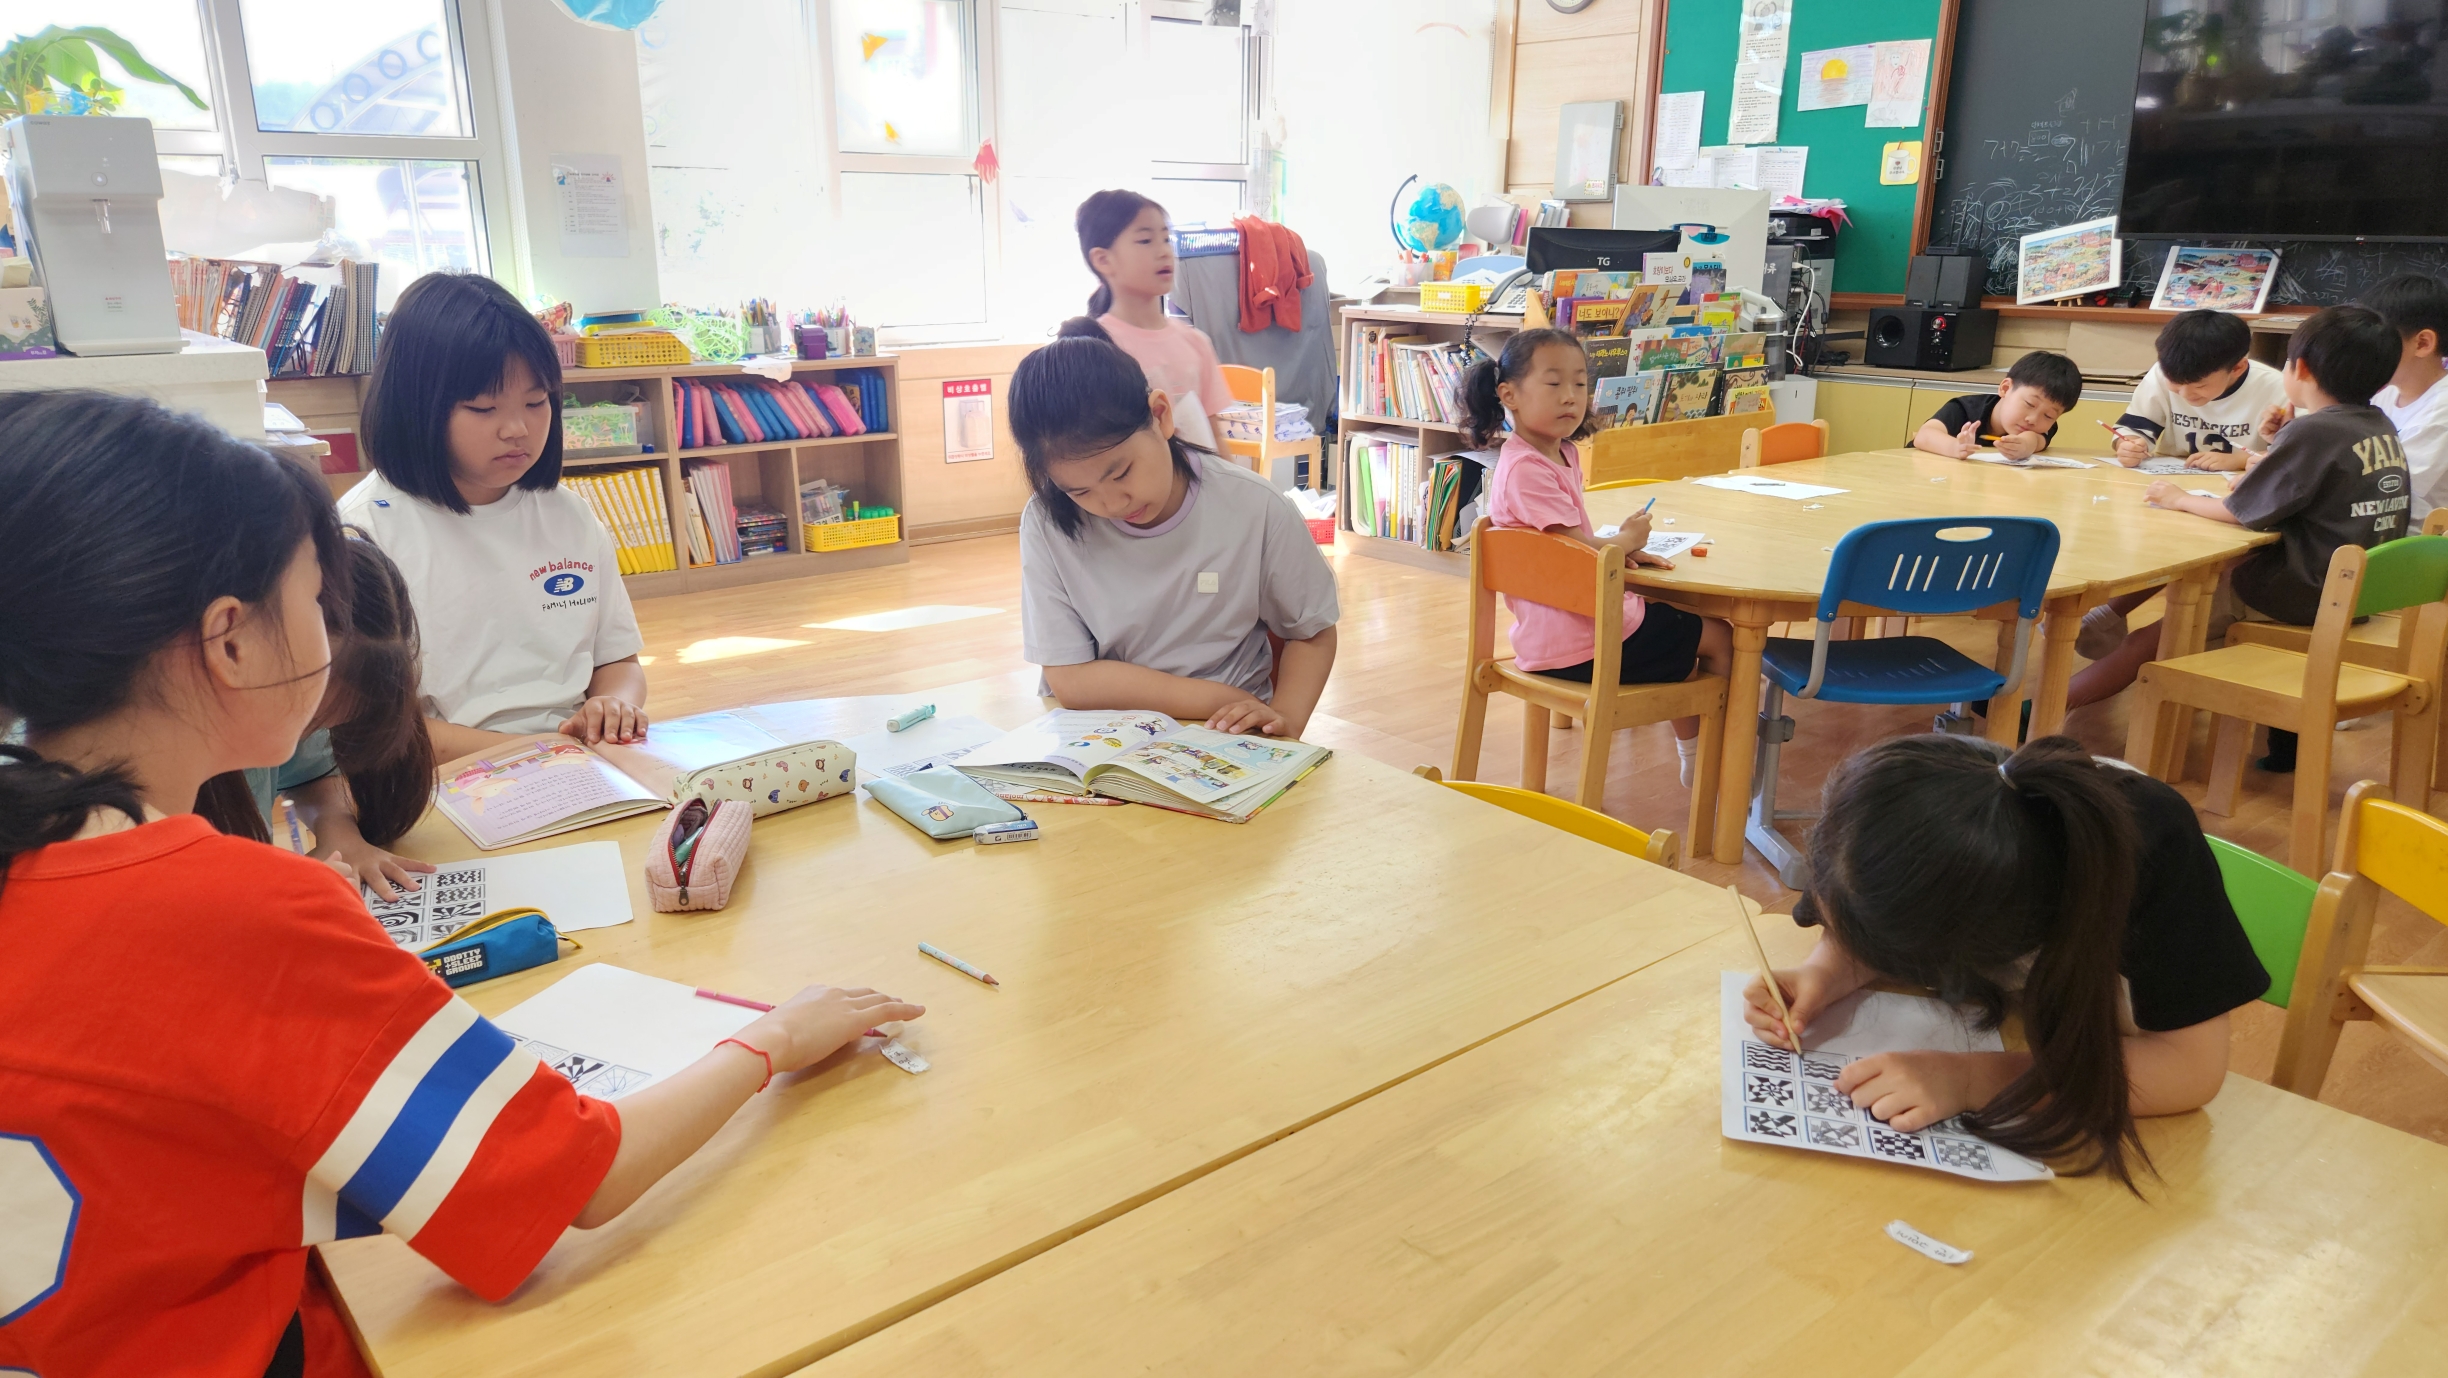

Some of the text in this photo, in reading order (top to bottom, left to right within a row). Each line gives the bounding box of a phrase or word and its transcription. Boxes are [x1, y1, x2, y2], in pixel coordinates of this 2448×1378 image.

[1597, 256, 1610, 266] TG
[1578, 307, 1620, 320] 너도 보이니?
[946, 384, 987, 394] 비상호출벨
[530, 558, 594, 581] new balance
[542, 600, 566, 612] FAMILY
[446, 960, 483, 976] GROUND
